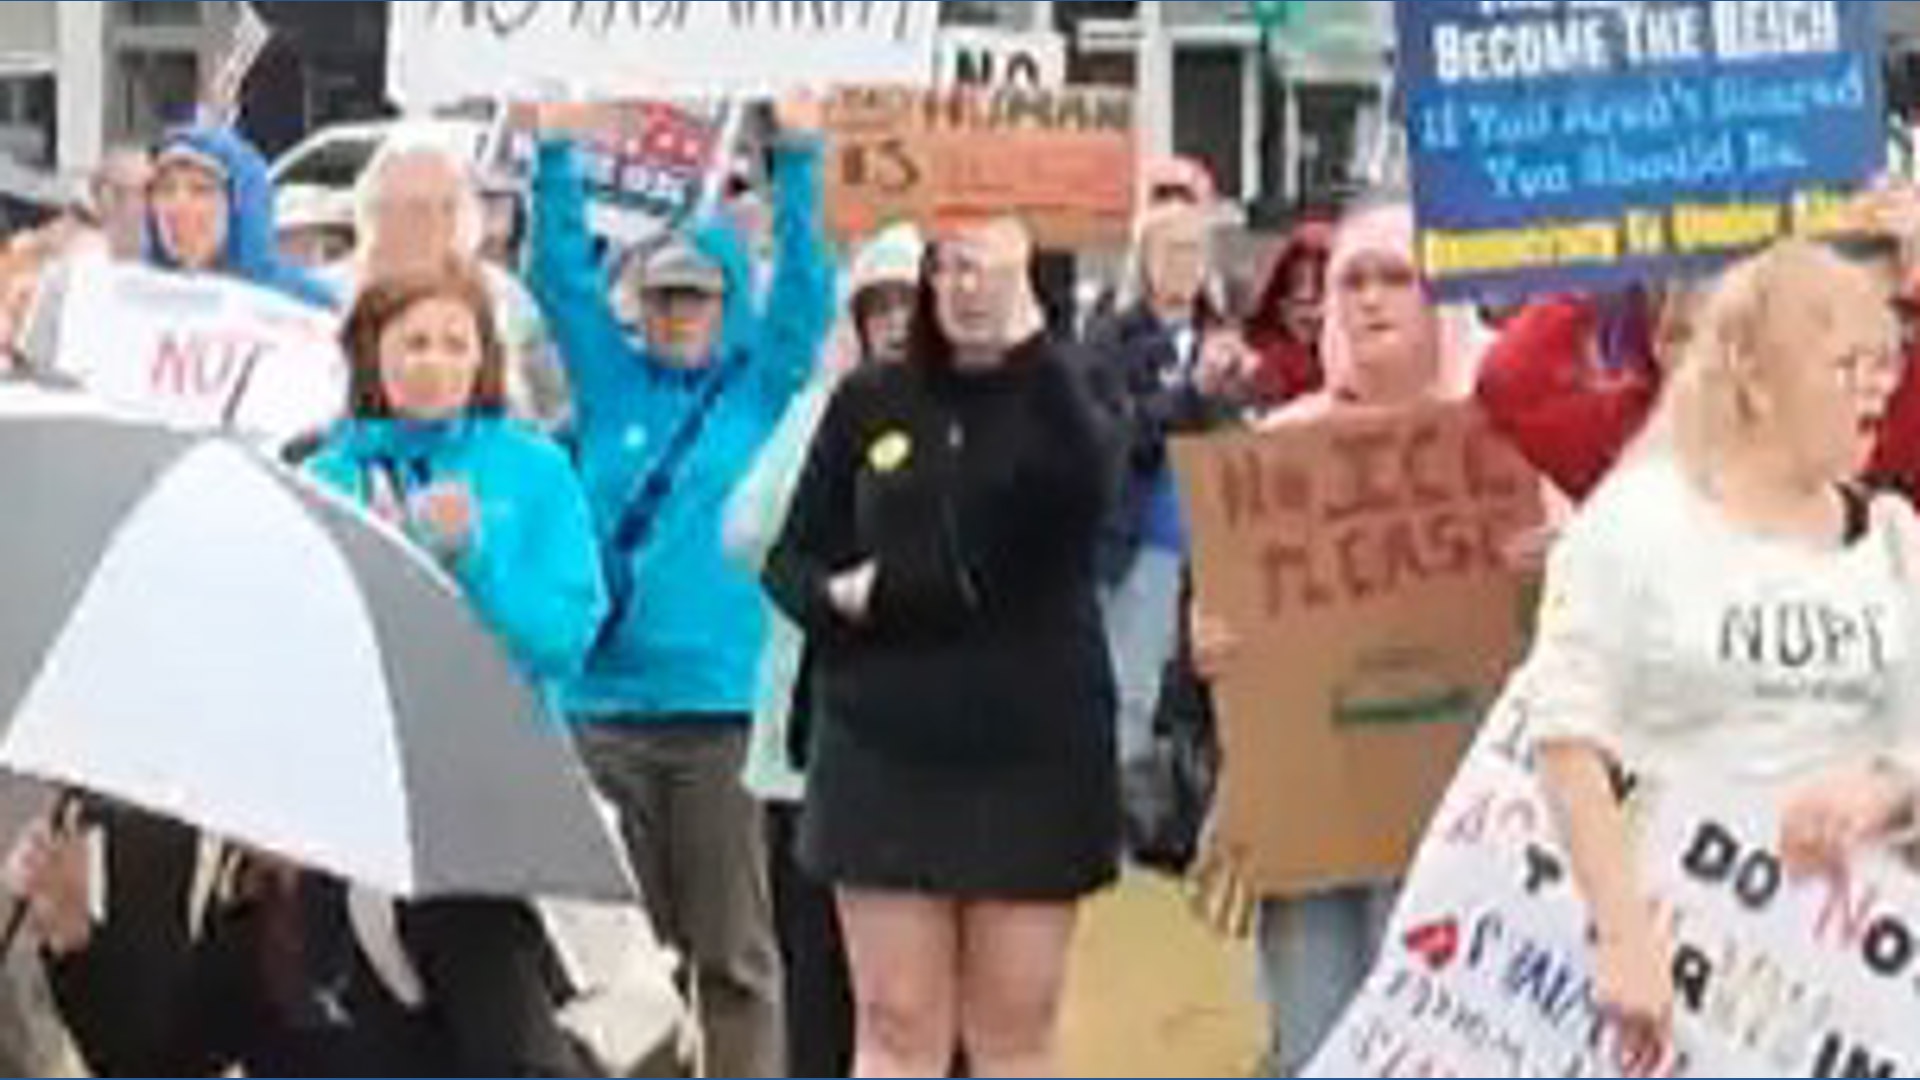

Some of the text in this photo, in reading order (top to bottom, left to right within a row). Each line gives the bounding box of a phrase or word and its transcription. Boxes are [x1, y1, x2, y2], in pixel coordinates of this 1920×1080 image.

[1433, 19, 1606, 84] BECOME
[1622, 4, 1702, 64] THE
[1682, 820, 1780, 910] DO
